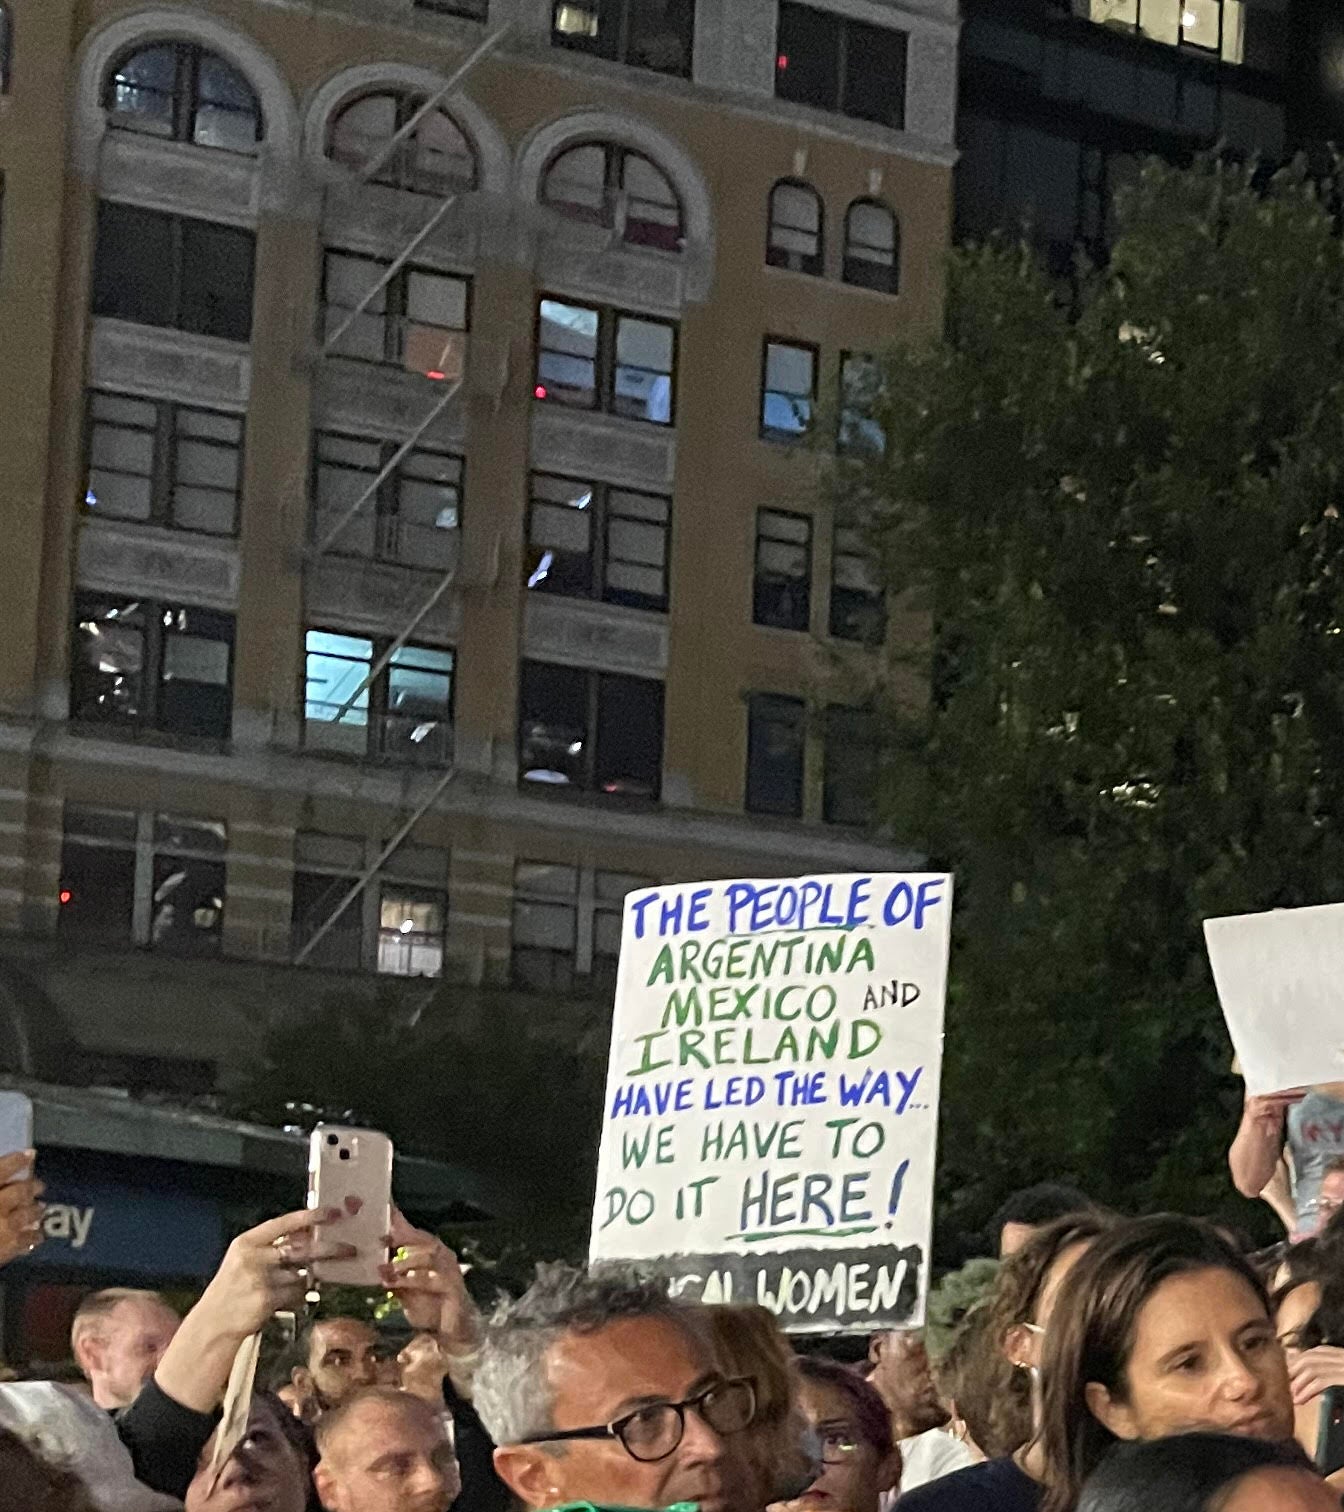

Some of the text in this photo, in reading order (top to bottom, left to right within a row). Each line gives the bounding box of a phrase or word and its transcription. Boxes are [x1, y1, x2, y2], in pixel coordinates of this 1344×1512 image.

[631, 877, 946, 939] THE PEOPLE OF
[646, 936, 875, 987] ARGENTINA
[661, 980, 921, 1029] MEXICO AND
[626, 1018, 883, 1077] IRELAND
[611, 1078, 694, 1120] HAVE
[704, 1075, 766, 1111] LED
[775, 1070, 828, 1106] THE
[622, 1117, 886, 1170] WE HAVE TO
[43, 1203, 95, 1248] ay
[600, 1186, 656, 1231] DO
[675, 1176, 721, 1220] IT
[757, 1258, 908, 1316] WOMEN
